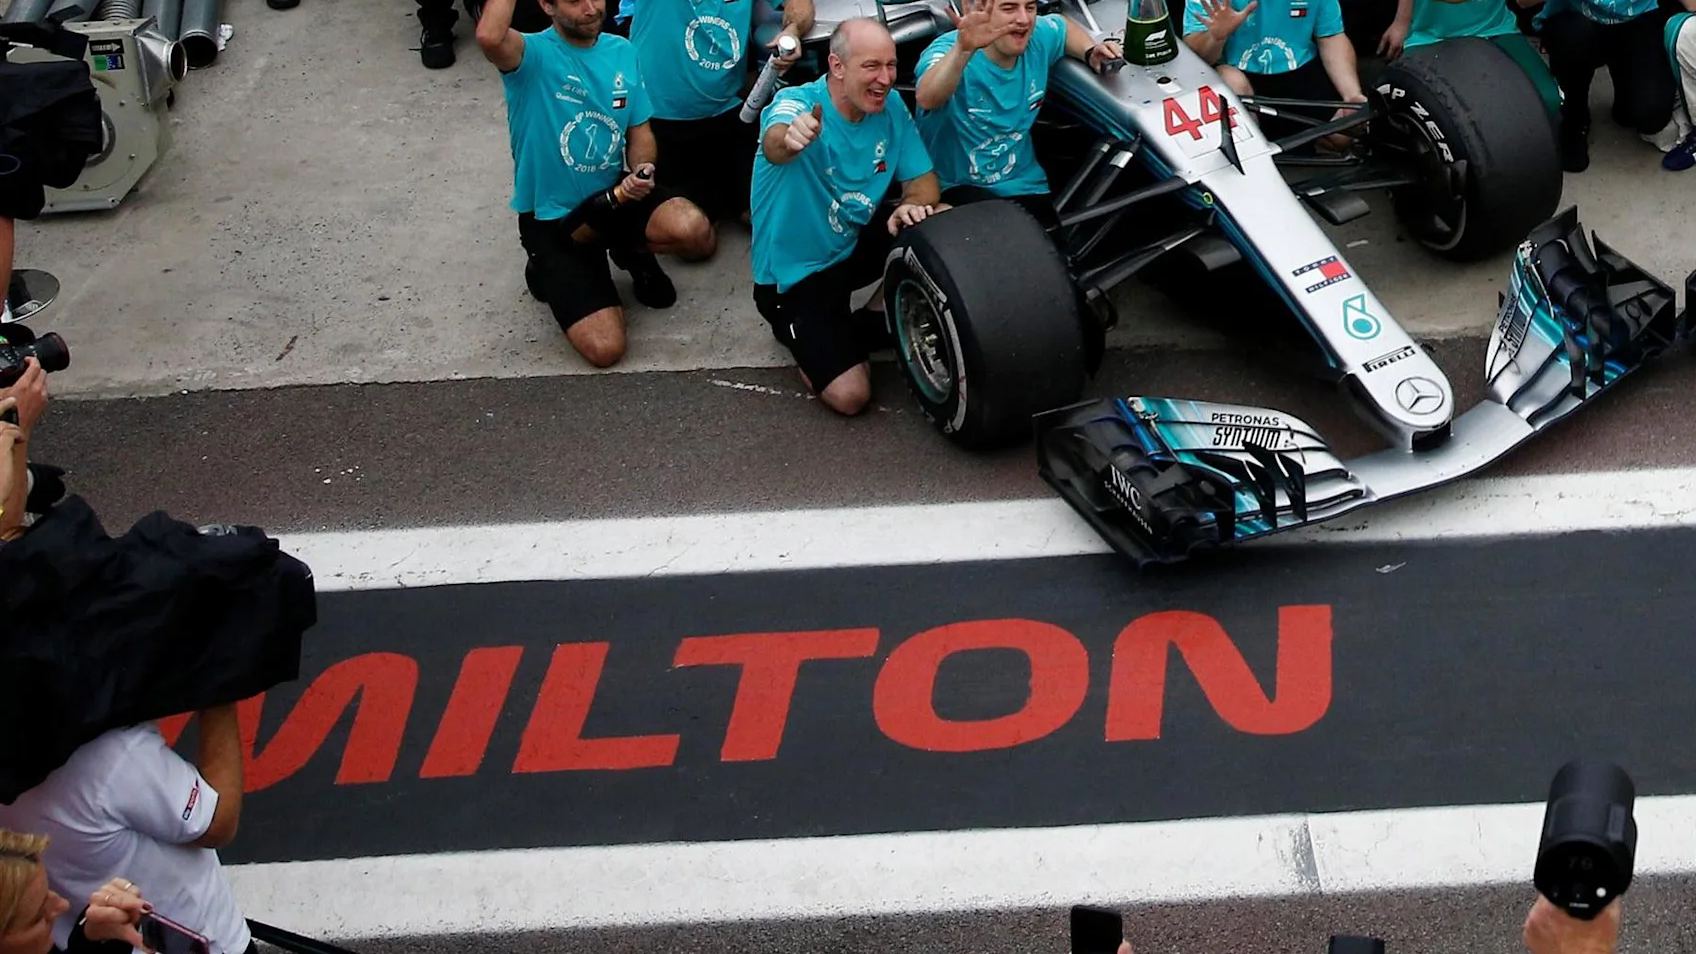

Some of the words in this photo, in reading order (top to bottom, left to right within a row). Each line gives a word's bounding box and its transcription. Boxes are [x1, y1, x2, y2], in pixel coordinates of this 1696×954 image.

[698, 58, 721, 71] 2018
[585, 110, 622, 132] WINNERS
[1162, 85, 1239, 141] 44
[585, 123, 598, 161] 1
[574, 163, 598, 174] 2018
[1362, 346, 1417, 373] PIRELLI
[1211, 412, 1280, 427] PETRONAS
[1110, 464, 1141, 510] IWC
